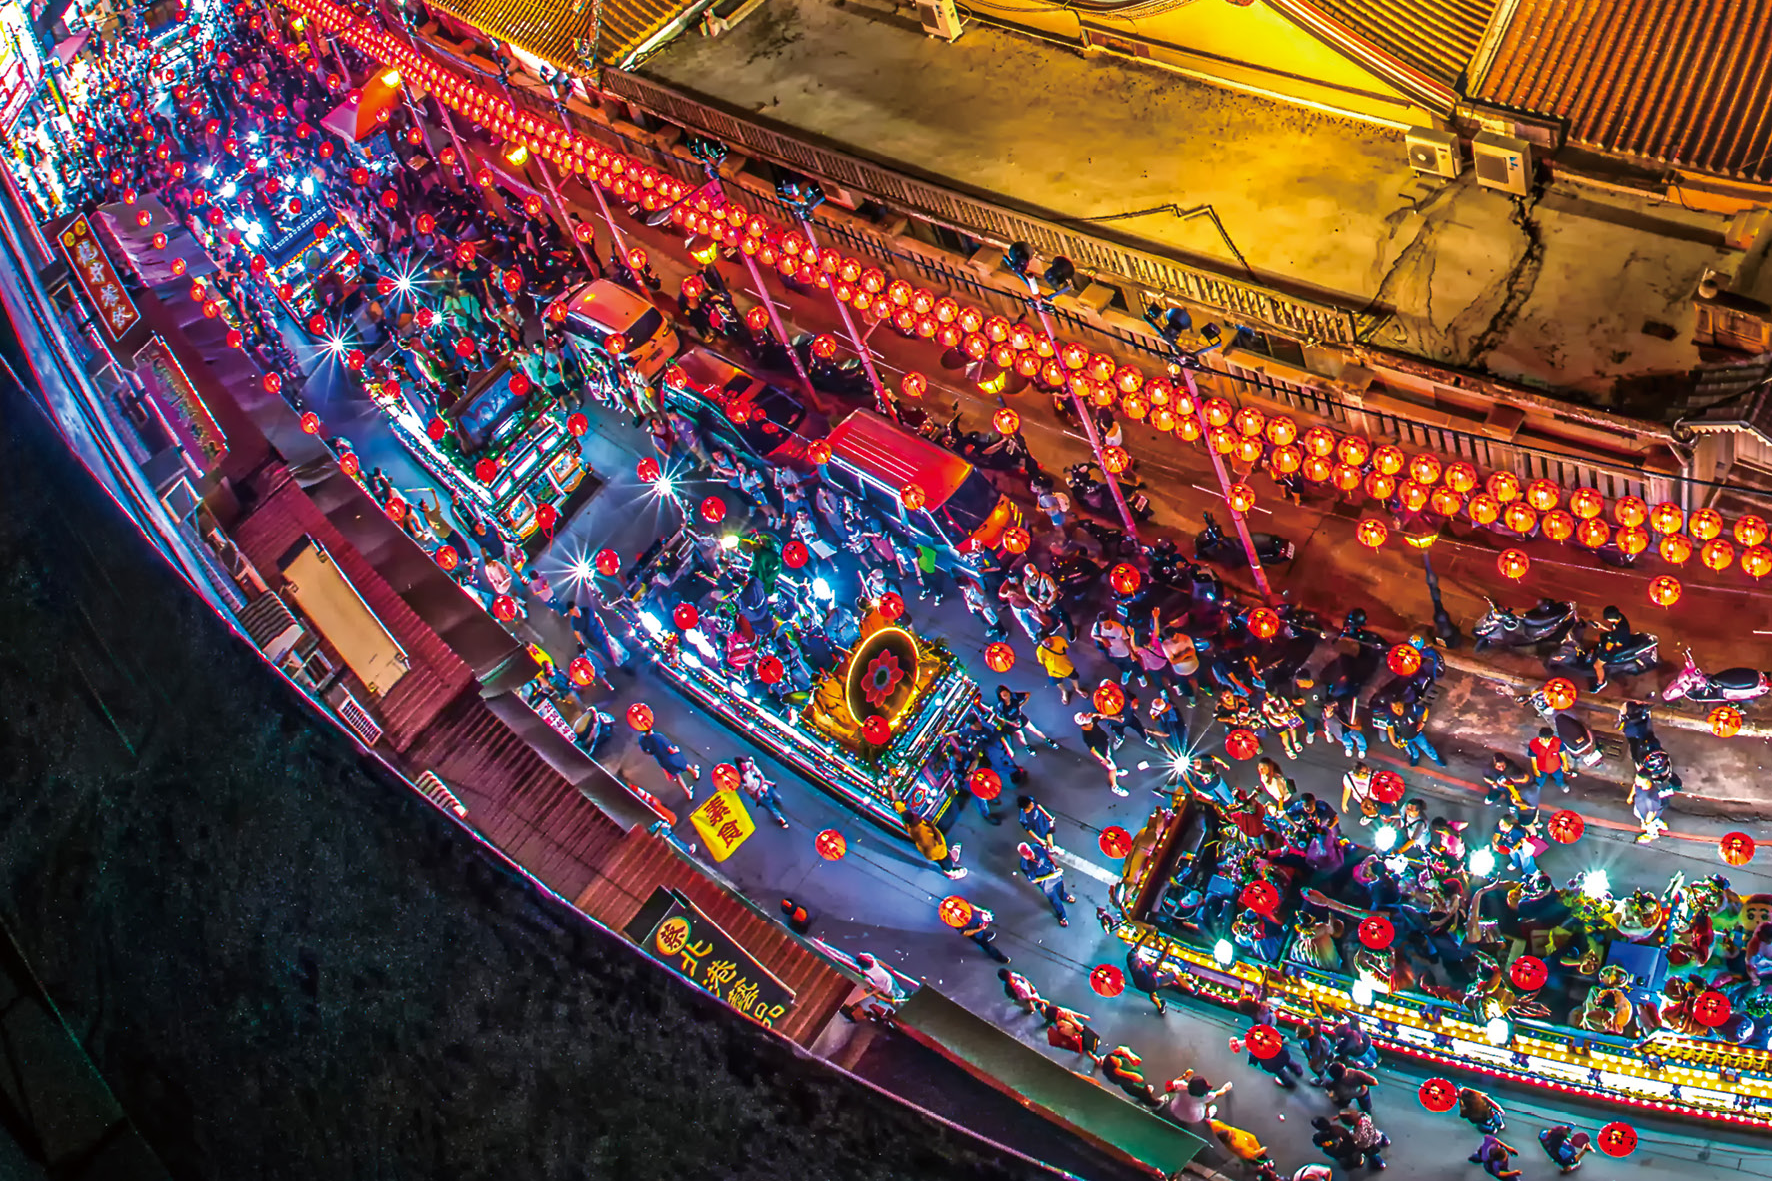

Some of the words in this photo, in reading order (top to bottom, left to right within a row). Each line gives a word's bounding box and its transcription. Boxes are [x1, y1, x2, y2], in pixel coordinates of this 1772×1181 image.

[704, 795, 743, 849] 素食
[681, 939, 785, 1029] 北港藝品
